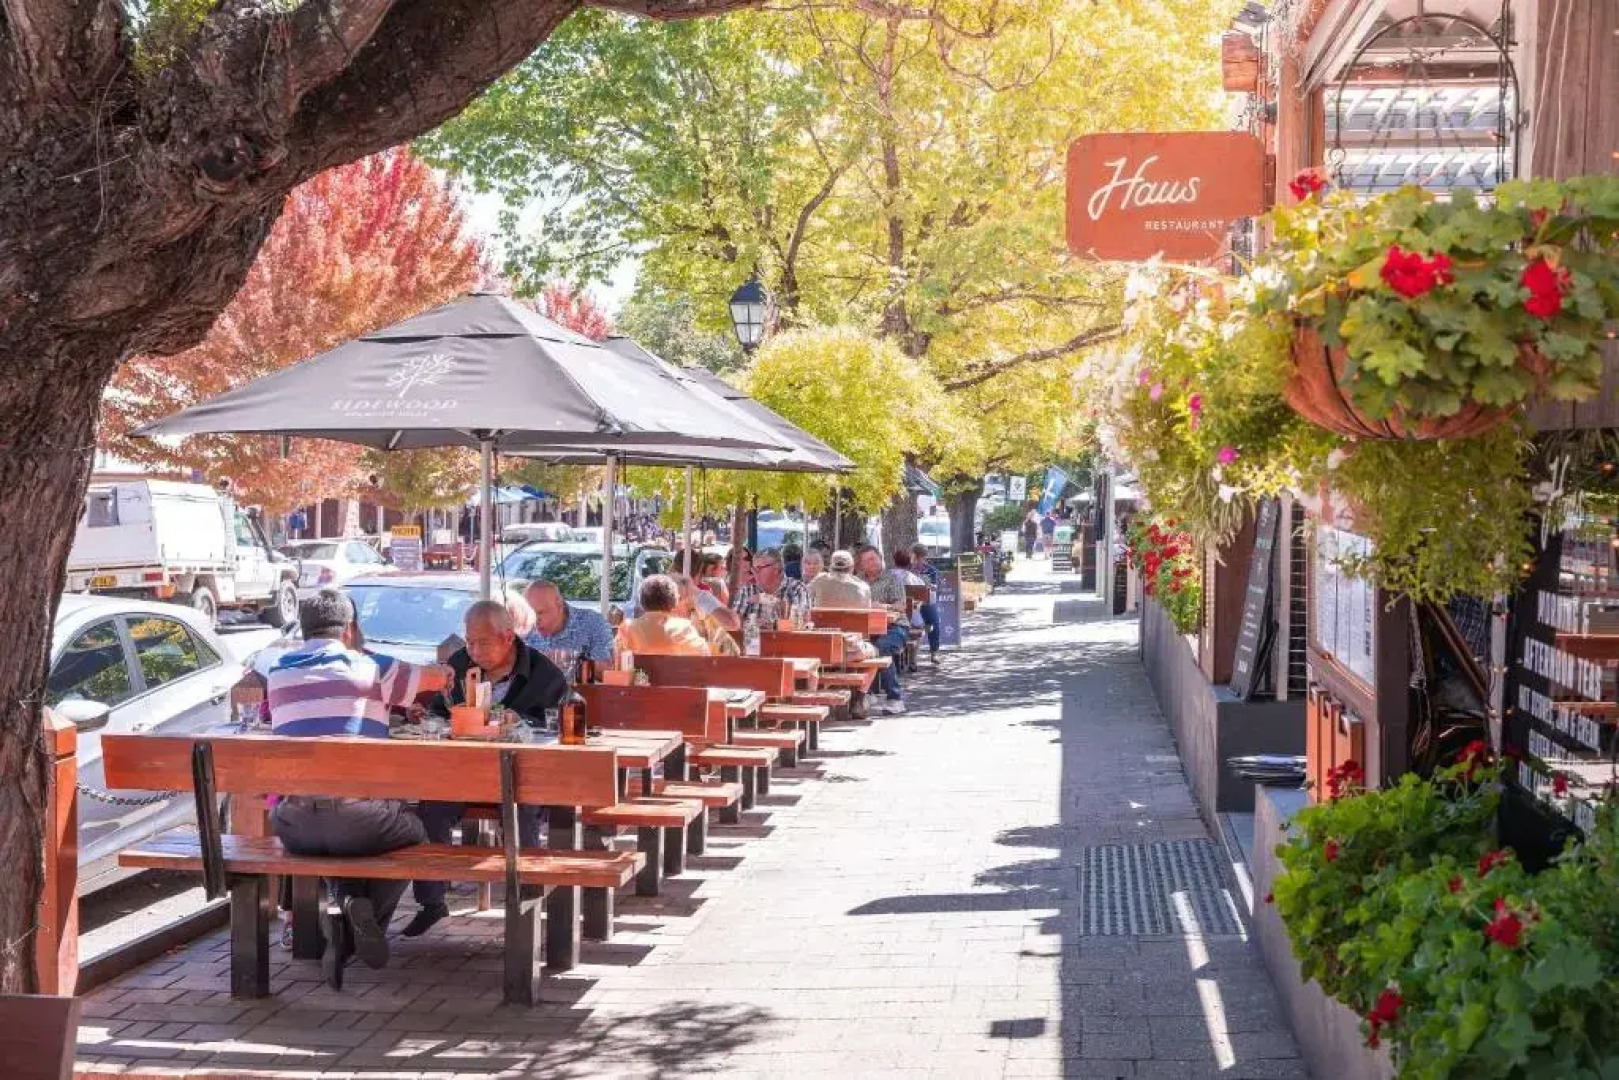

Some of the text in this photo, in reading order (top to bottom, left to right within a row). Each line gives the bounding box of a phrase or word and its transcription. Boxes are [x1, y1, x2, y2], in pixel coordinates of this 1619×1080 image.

[1087, 155, 1201, 221] Haus
[1144, 220, 1225, 230] RESTAURANT
[1523, 636, 1602, 702] AFTERNOON TEAS
